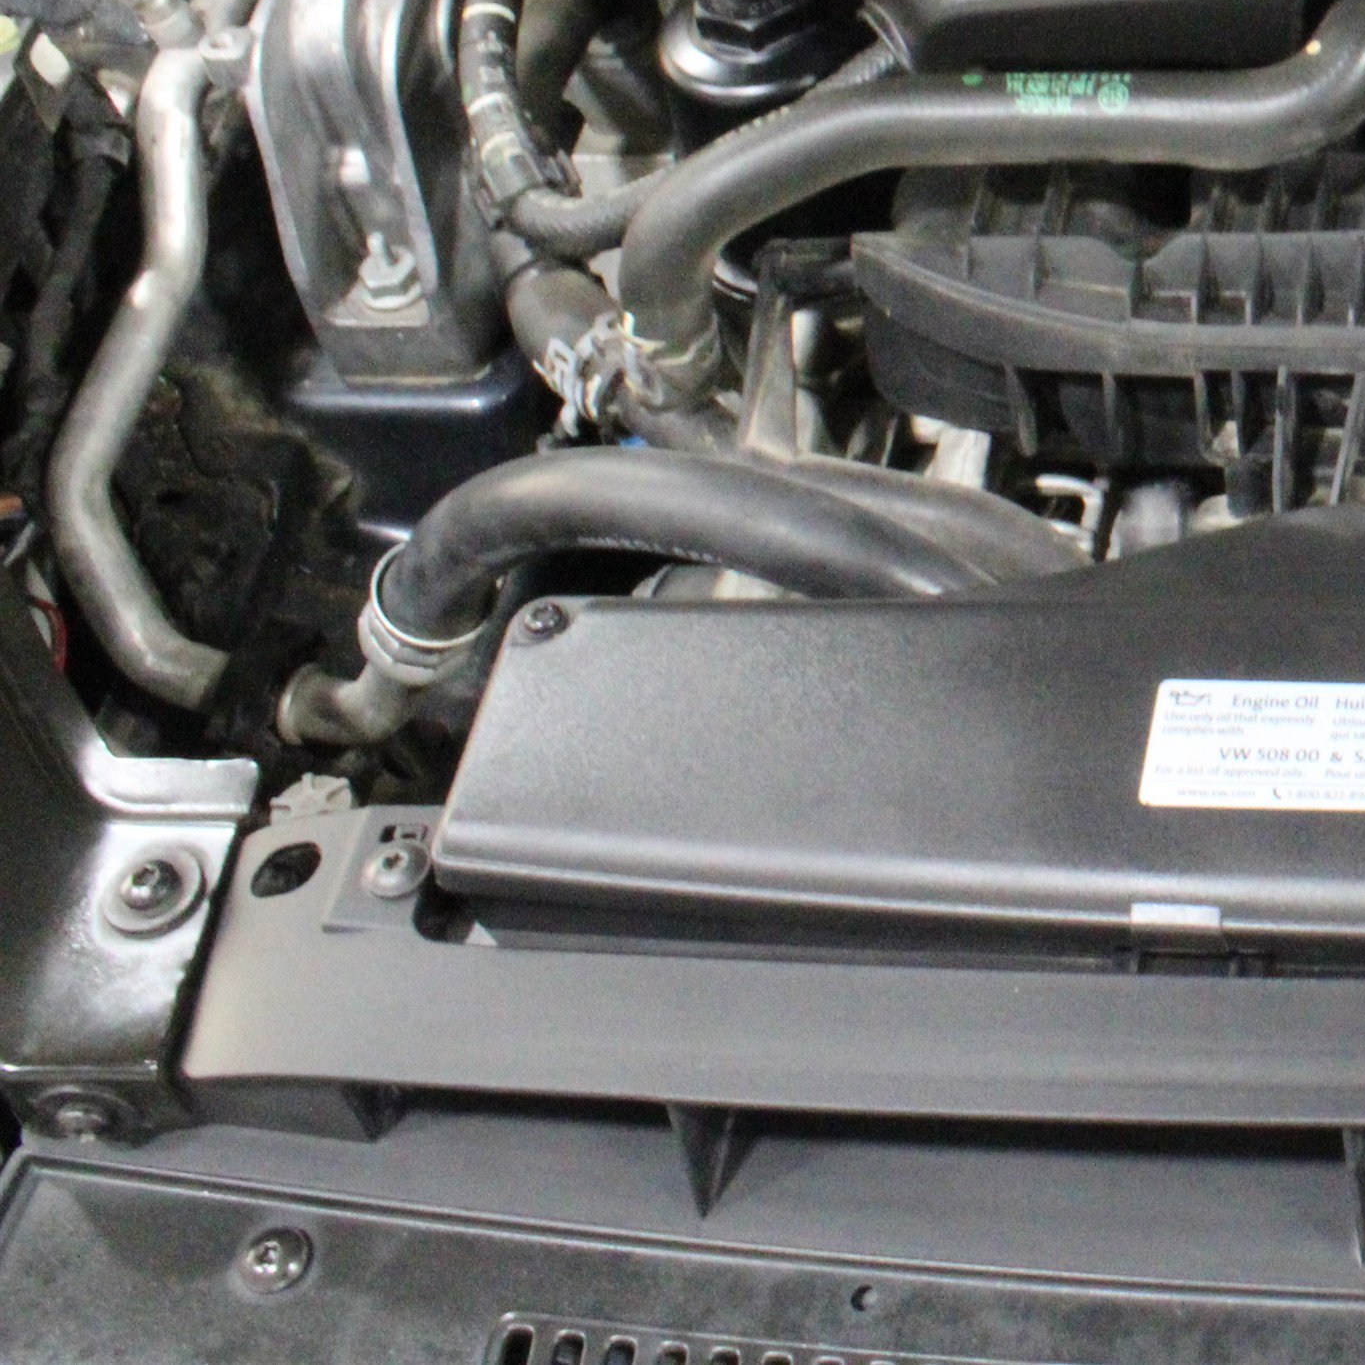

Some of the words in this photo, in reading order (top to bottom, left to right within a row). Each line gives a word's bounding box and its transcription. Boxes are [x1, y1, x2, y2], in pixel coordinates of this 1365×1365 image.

[1232, 695, 1290, 711] Engine
[1295, 696, 1319, 709] Oil
[1234, 713, 1258, 723] that
[1219, 747, 1252, 762] VW
[1257, 748, 1289, 762] 508
[1295, 749, 1320, 762] 00
